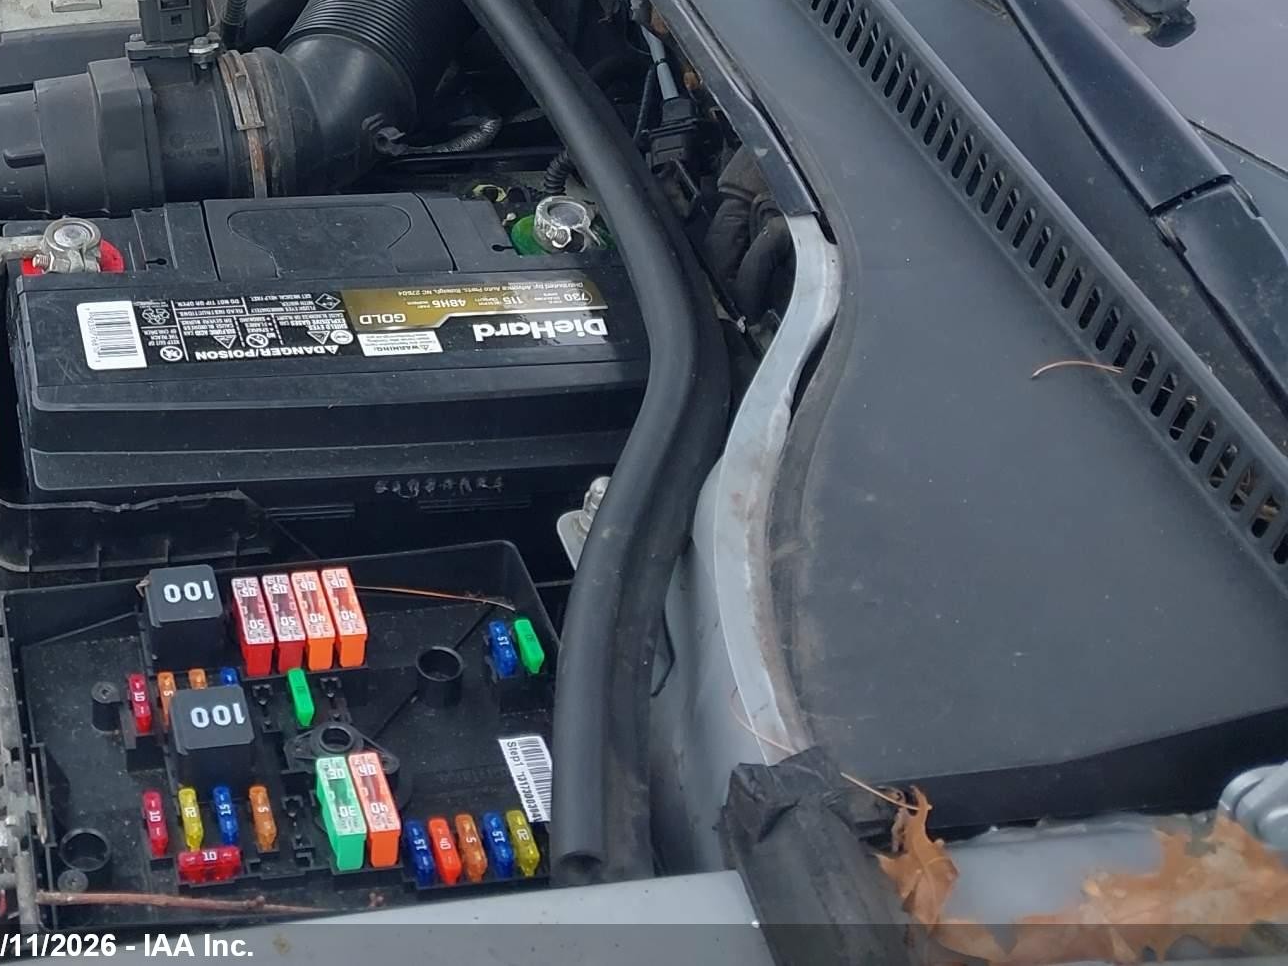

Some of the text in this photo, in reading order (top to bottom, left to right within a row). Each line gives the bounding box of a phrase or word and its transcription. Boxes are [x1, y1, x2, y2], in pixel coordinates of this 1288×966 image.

[503, 296, 524, 304] 115
[564, 292, 589, 302] 730
[359, 313, 407, 325] GOLD
[472, 318, 608, 341] DieHard
[195, 346, 326, 360] DANGER/POISON
[163, 580, 214, 603] 100
[280, 616, 296, 627] 50
[307, 613, 325, 624] 40
[339, 610, 356, 621] 40
[248, 618, 265, 629] 50
[496, 636, 510, 646] 15
[190, 703, 245, 728] 100
[507, 741, 525, 767] Step1
[218, 803, 232, 816] 15
[338, 805, 356, 817] 30
[370, 802, 388, 814] 40
[149, 810, 161, 822] 10
[492, 830, 506, 843] 15
[413, 838, 427, 851] 15
[201, 851, 218, 861] 10
